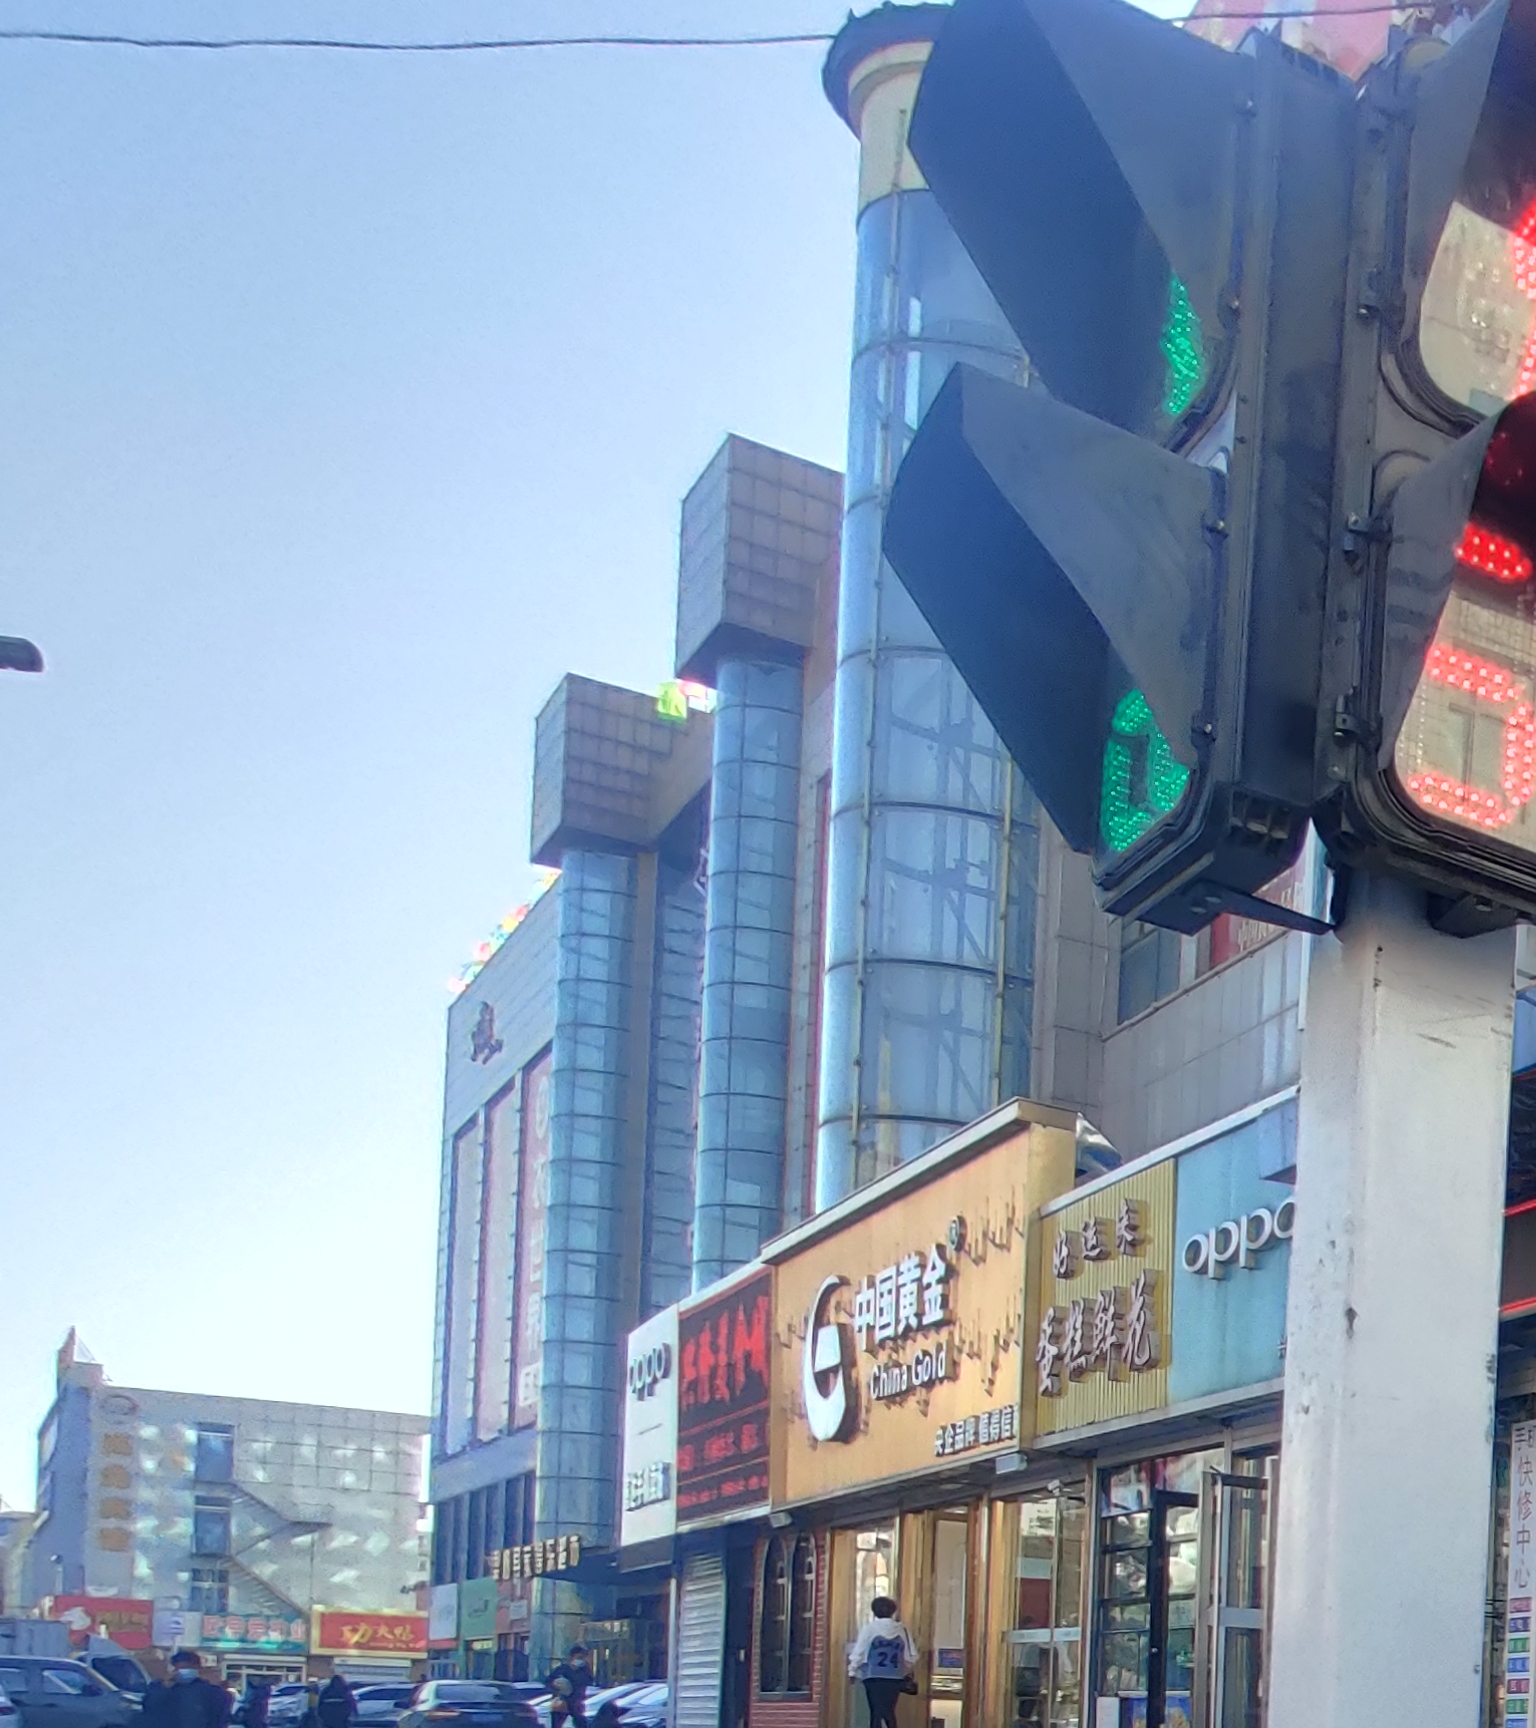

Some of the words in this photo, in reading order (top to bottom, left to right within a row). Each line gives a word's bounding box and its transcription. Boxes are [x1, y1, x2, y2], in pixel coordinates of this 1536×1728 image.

[855, 1244, 950, 1351] 中国黄金
[870, 1358, 908, 1400] China
[911, 1340, 948, 1386] Gold
[877, 1651, 899, 1669] 24
